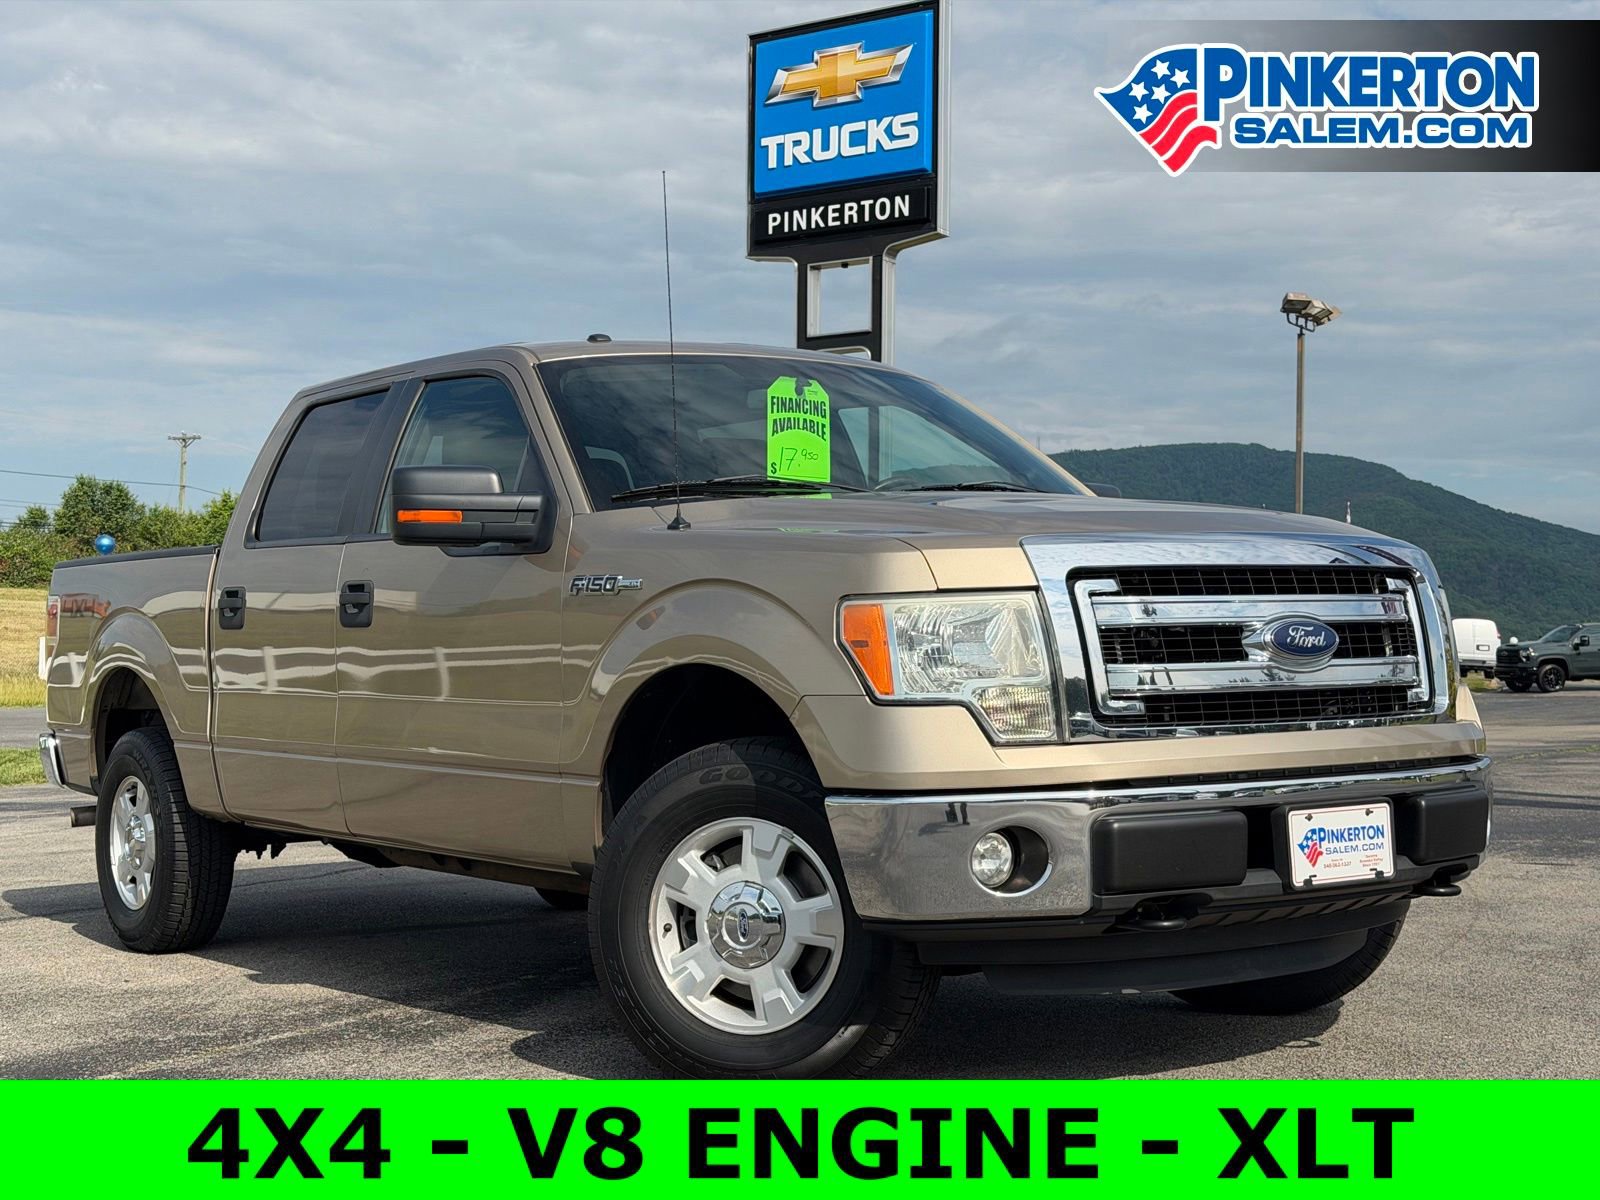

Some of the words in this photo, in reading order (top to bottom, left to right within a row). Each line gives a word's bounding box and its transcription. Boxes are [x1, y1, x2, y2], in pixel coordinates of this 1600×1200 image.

[761, 112, 918, 169] TRUCKS
[768, 195, 910, 234] PINKERTON
[771, 396, 827, 419] FINANCING
[772, 417, 827, 441] AVAILABLE
[1287, 625, 1326, 648] Ford
[1318, 825, 1384, 848] PINKERTON
[1325, 842, 1384, 854] SALEM.COM
